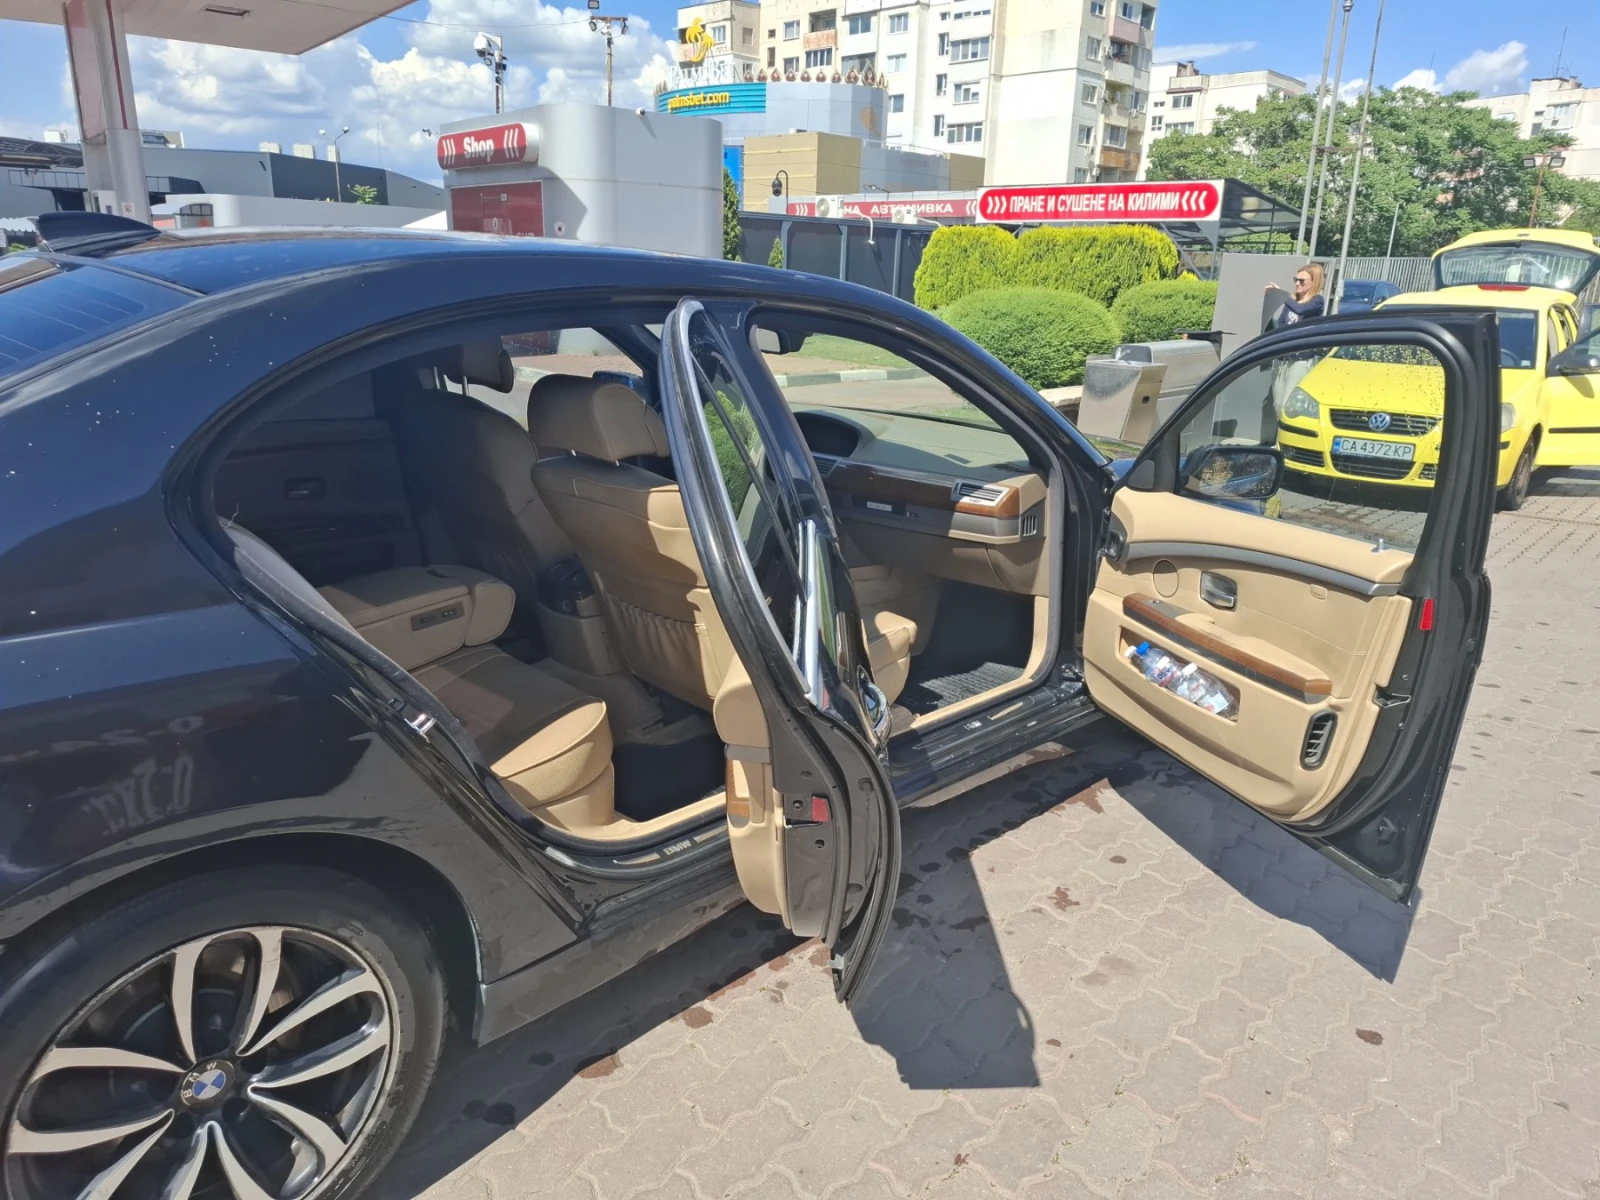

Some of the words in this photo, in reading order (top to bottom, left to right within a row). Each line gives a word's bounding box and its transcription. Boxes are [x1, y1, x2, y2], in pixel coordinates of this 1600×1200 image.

[667, 92, 730, 113] palmsbet.com
[463, 135, 495, 162] Shop
[870, 203, 954, 215] АВТИВКА
[1009, 195, 1044, 213] ПРАНЕ
[1047, 195, 1055, 212] И
[1057, 193, 1106, 212] СУШЕНЕ
[1108, 193, 1125, 211] НА
[1127, 191, 1180, 211] КИЛИМИ
[1341, 439, 1357, 452] CA
[1360, 441, 1392, 456] 4372
[1393, 444, 1412, 458] KP
[663, 839, 692, 855] BMW
[183, 1061, 217, 1098] BMW
